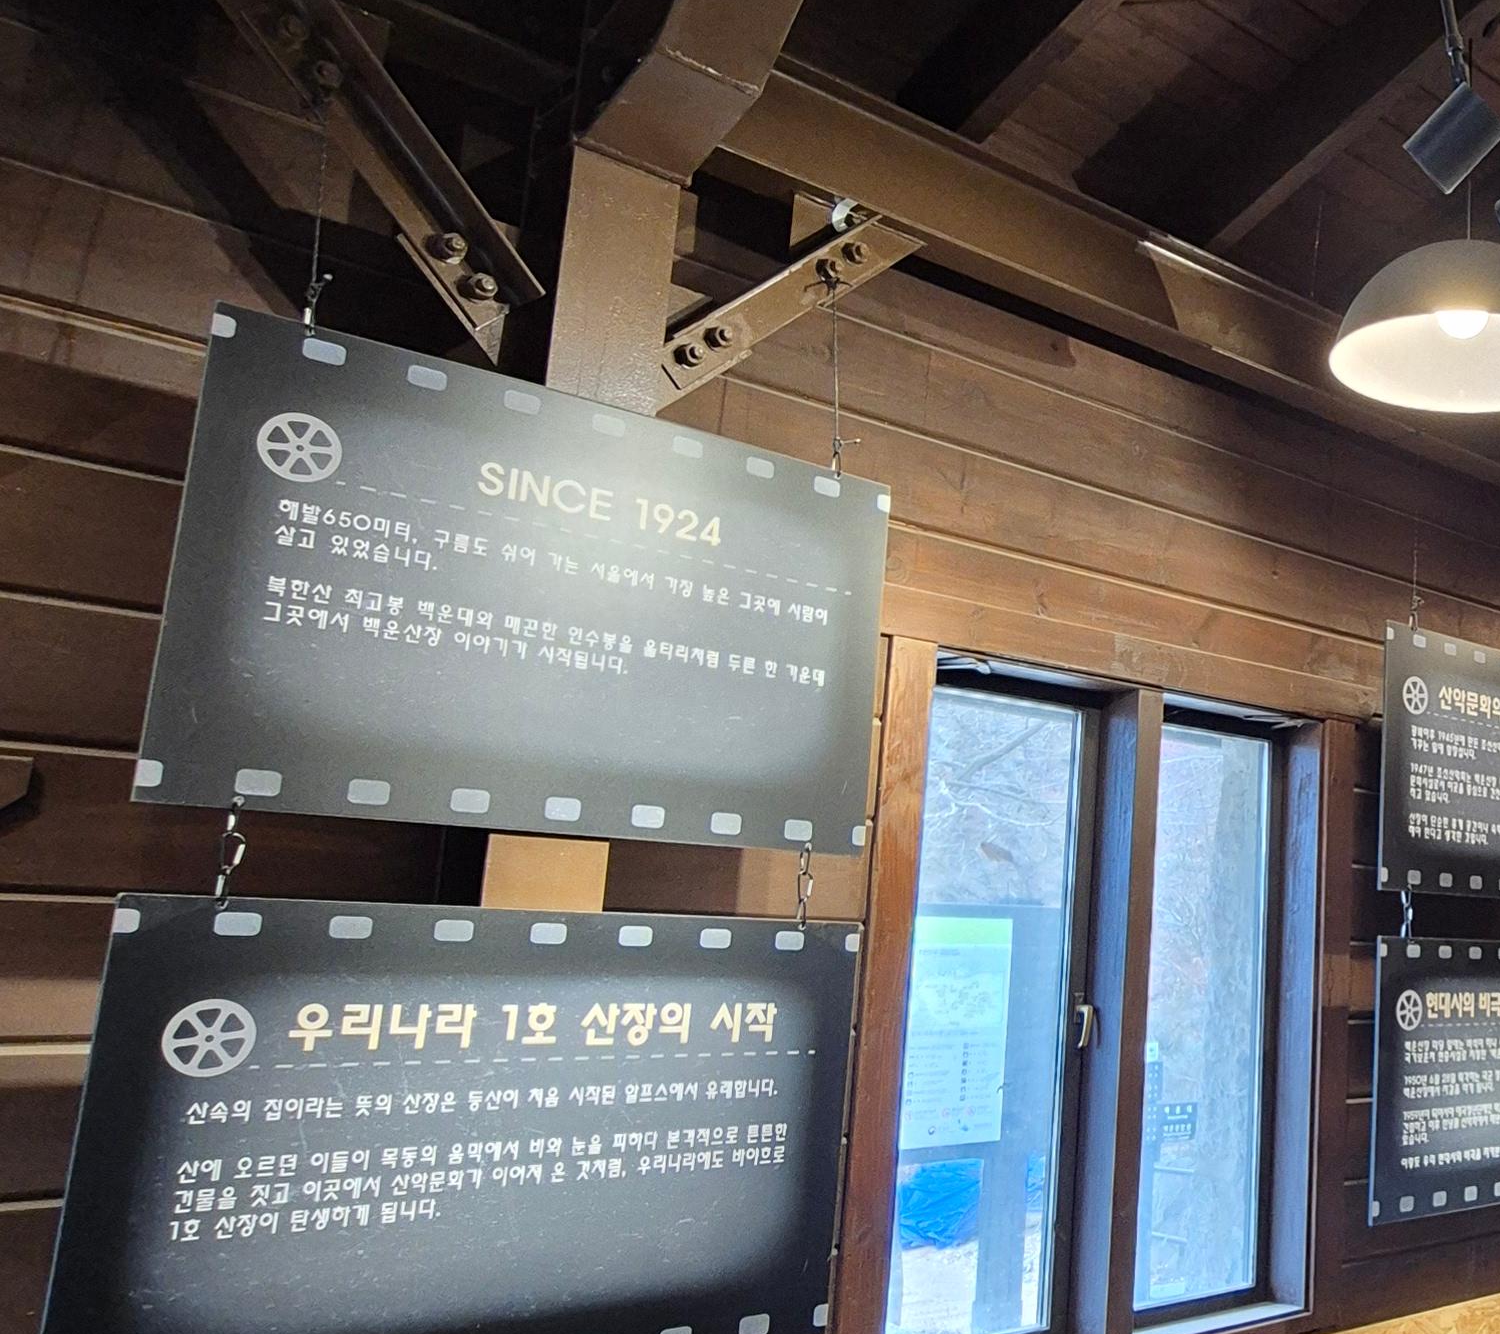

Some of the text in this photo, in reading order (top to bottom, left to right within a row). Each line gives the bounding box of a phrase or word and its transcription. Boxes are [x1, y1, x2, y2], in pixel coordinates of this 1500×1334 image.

[477, 462, 722, 547] SINCE 1924
[275, 525, 437, 571] 살고 있었습니다.
[434, 529, 488, 556] 구름도
[590, 562, 654, 590] 서울에서
[739, 591, 780, 616] 그곳에
[788, 603, 827, 626] 사람이
[263, 601, 628, 675] 그곳에서 백운산장 이야기가 시작됩니다.
[268, 575, 332, 604] 북한산
[343, 588, 404, 618] 최고봉
[418, 600, 493, 630] 백운대와
[568, 626, 632, 654] 인수봉을
[765, 660, 777, 678] 한
[786, 664, 825, 687] 가운데
[288, 1002, 778, 1052] 우리나라 1호 산장의 시작
[1426, 992, 1474, 1019] 현대사의
[186, 1078, 778, 1125] 산속의 집이라는 뜻의 산장은 등산이 처음 시작된 알프스에서 유래합니다.
[173, 1149, 725, 1214] 건물을 짓고 이곳에서 산악문화가 이어져 온 것처럼, 우리나라에도
[177, 1126, 738, 1184] 산에 오르던 이들이 목동의 움막에서 비와 눈을 피하다 본격적으로
[170, 1198, 441, 1241] 1호 산장이 탄생하게 됩니다.
